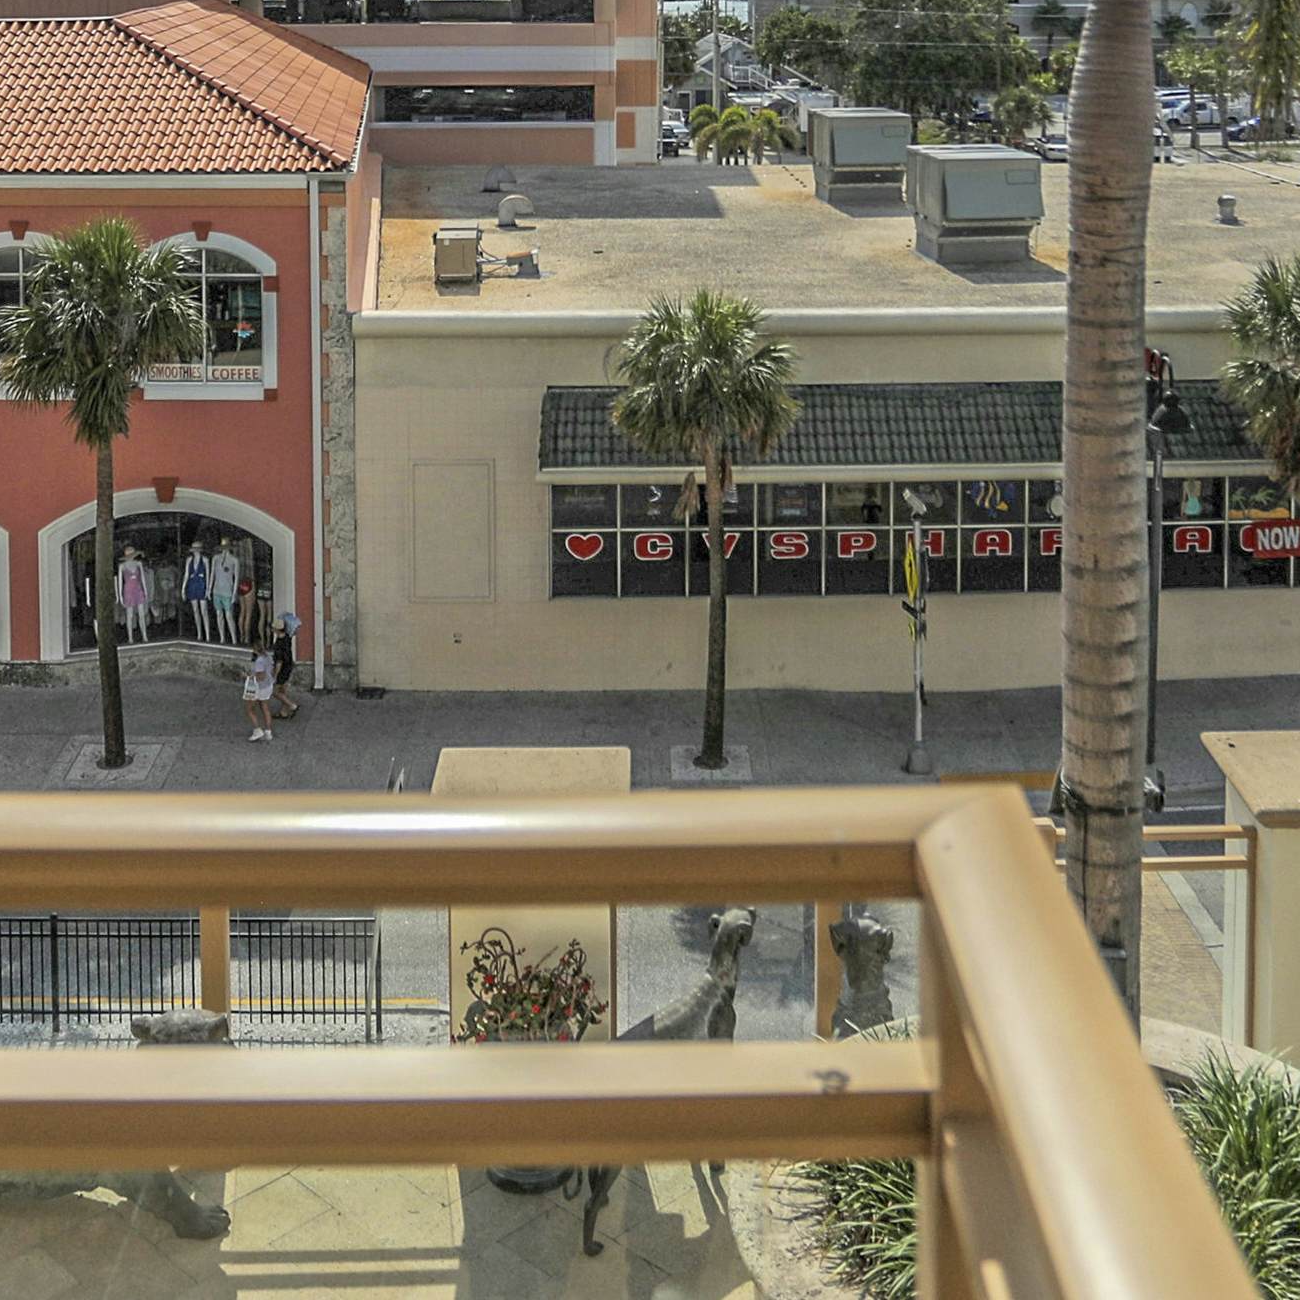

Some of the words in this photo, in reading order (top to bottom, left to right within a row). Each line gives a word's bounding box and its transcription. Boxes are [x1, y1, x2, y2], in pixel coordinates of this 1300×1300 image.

[150, 366, 202, 379] SMOOTHIES
[211, 368, 259, 380] COFFEE
[1256, 525, 1300, 550] NOW
